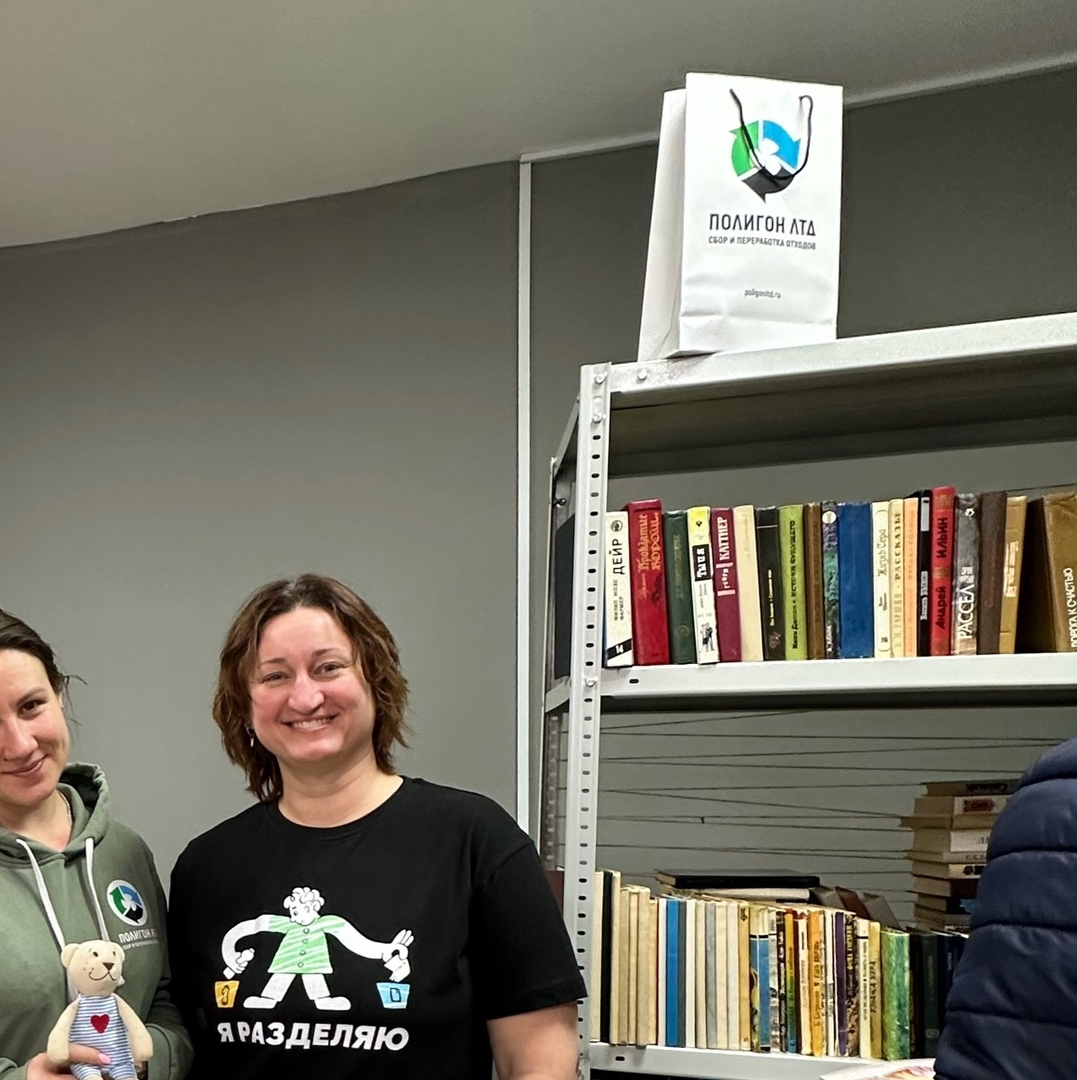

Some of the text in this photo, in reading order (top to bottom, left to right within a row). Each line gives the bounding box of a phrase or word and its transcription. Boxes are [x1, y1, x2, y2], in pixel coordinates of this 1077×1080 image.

[708, 236, 816, 250] СБОР И ПЕРЕРАБОТКА ОТХОДОВ
[709, 213, 816, 236] ПОЛИГОН ЛТД
[610, 538, 626, 576] ДЕЙР
[717, 516, 729, 560] КАТТНЕР
[894, 513, 902, 580] РАССКАЗЫ
[935, 517, 948, 629] Андрей ИЛЬИН
[1063, 567, 1077, 607] СЧАСТЬЮ
[957, 584, 975, 639] РАССЕЛ
[217, 1022, 410, 1050] Я РАЗДЕЛЯЮ
